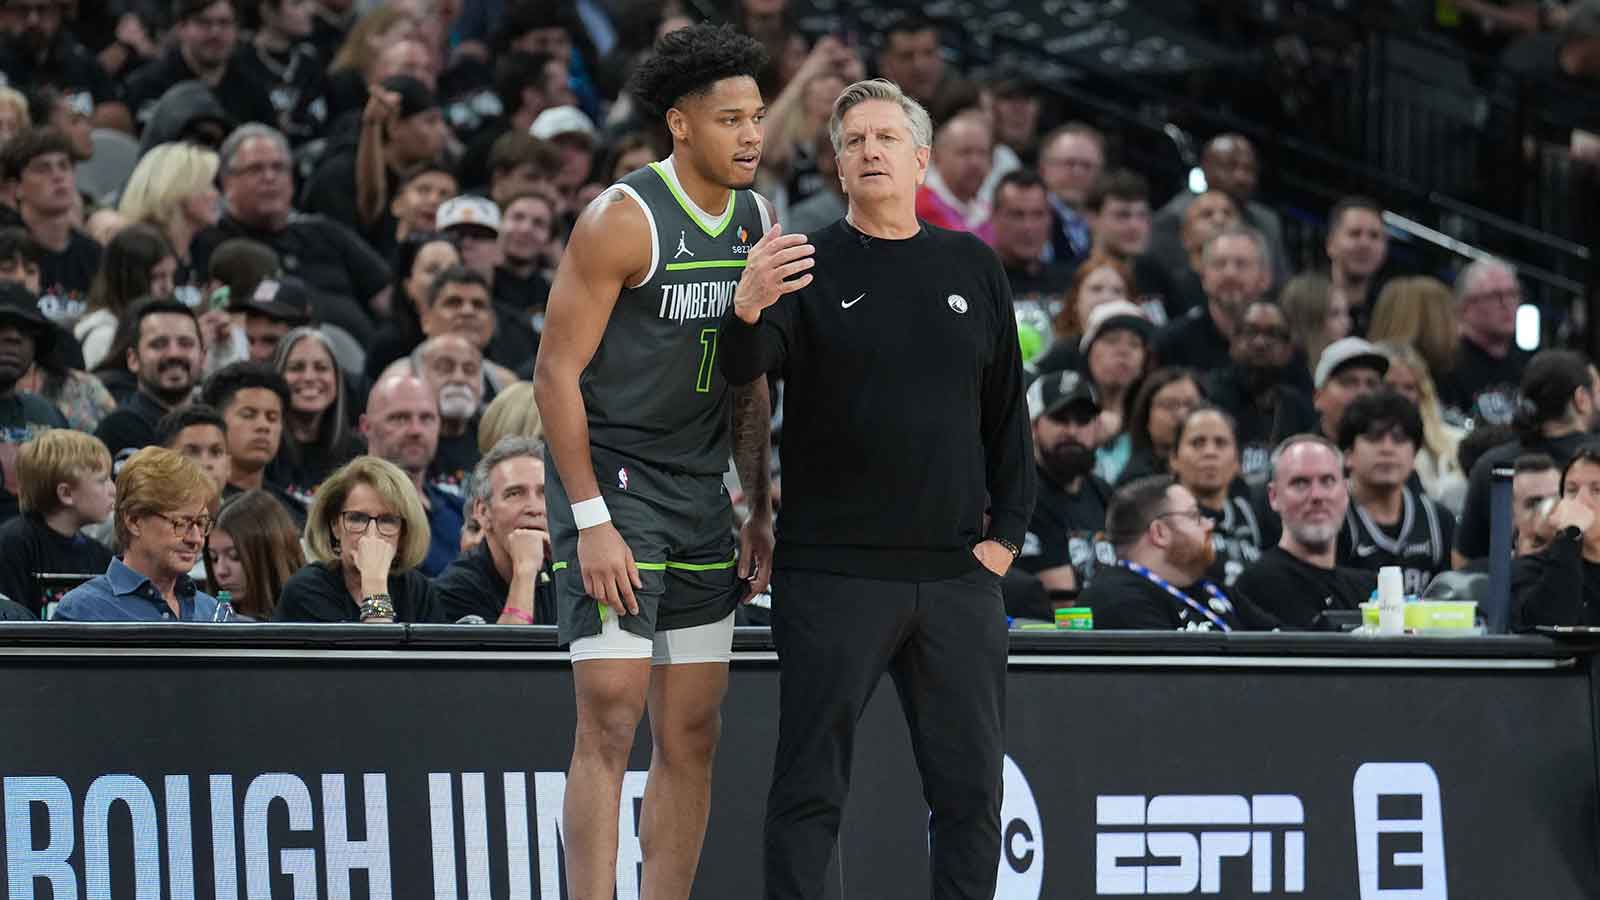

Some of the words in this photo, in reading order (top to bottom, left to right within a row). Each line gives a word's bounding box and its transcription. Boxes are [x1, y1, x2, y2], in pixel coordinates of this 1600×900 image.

[696, 328, 717, 392] 1
[3, 772, 393, 900] ROUGH
[1096, 794, 1305, 895] ESPN
